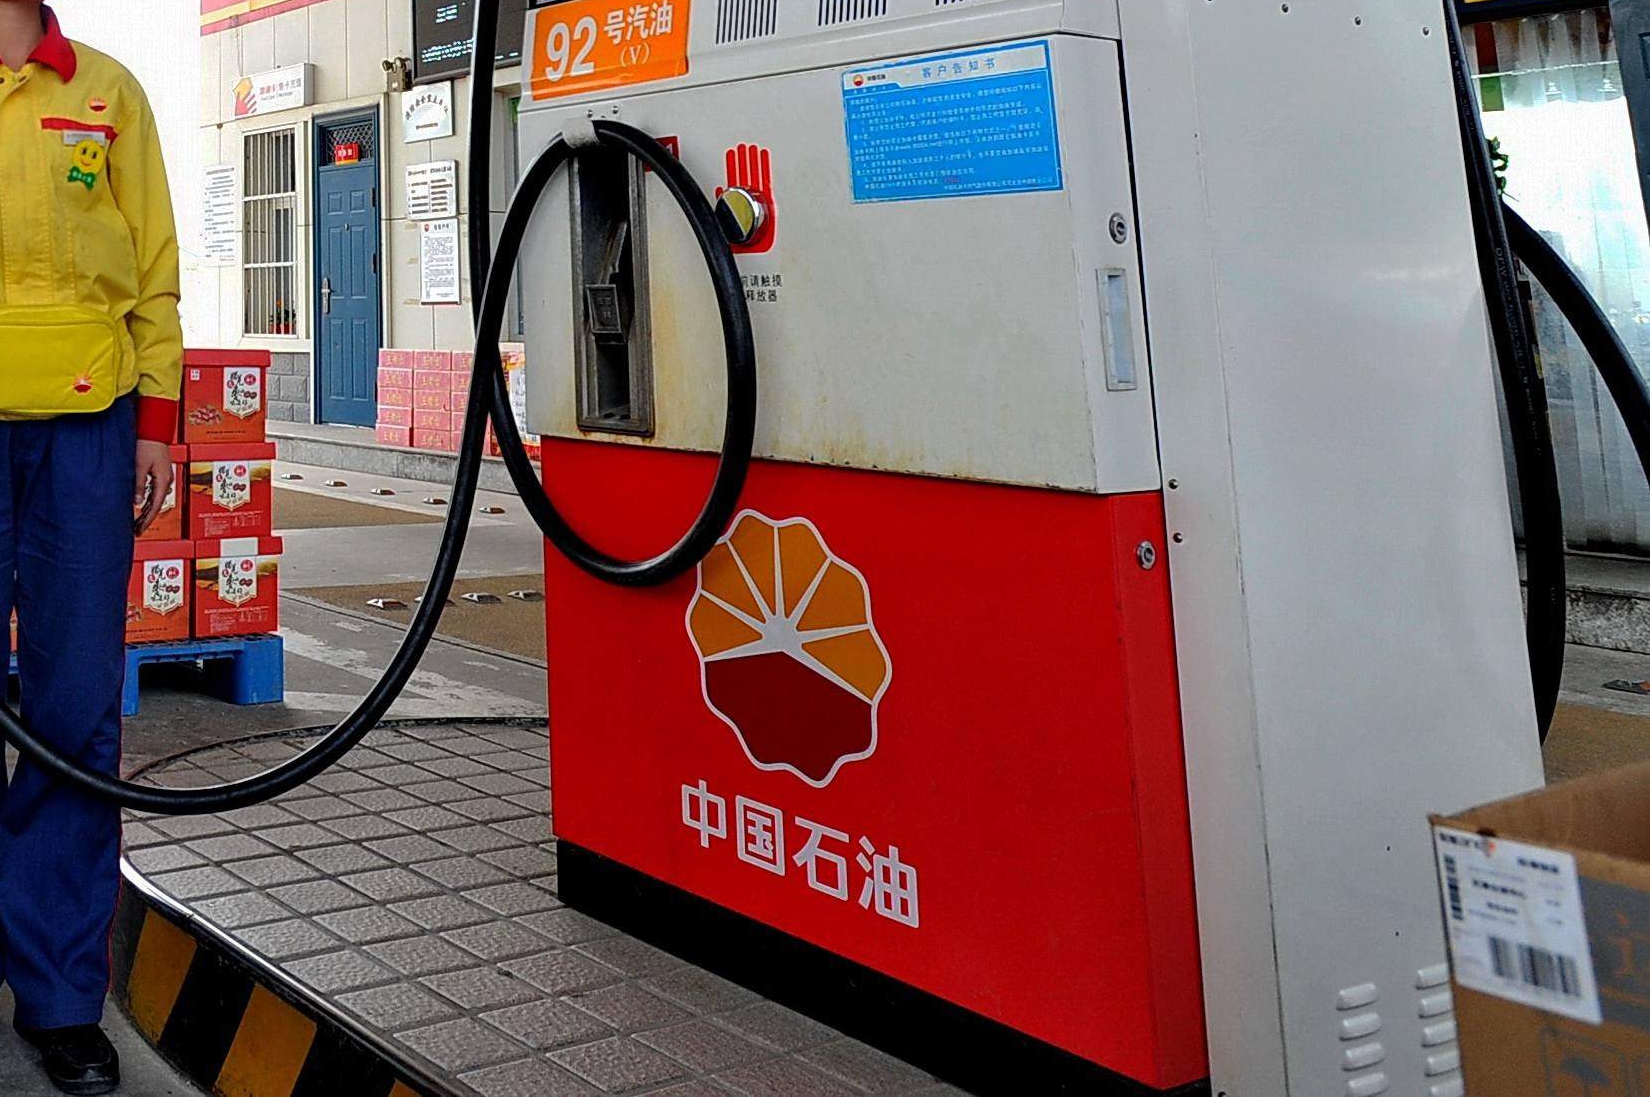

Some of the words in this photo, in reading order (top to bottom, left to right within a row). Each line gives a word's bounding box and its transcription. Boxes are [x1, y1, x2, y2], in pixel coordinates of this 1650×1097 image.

[545, 17, 598, 82] 92
[603, 0, 674, 46] 号汽油
[619, 41, 651, 68] (V)
[921, 58, 996, 79] 客户告知书
[680, 779, 919, 929] 中国石油
